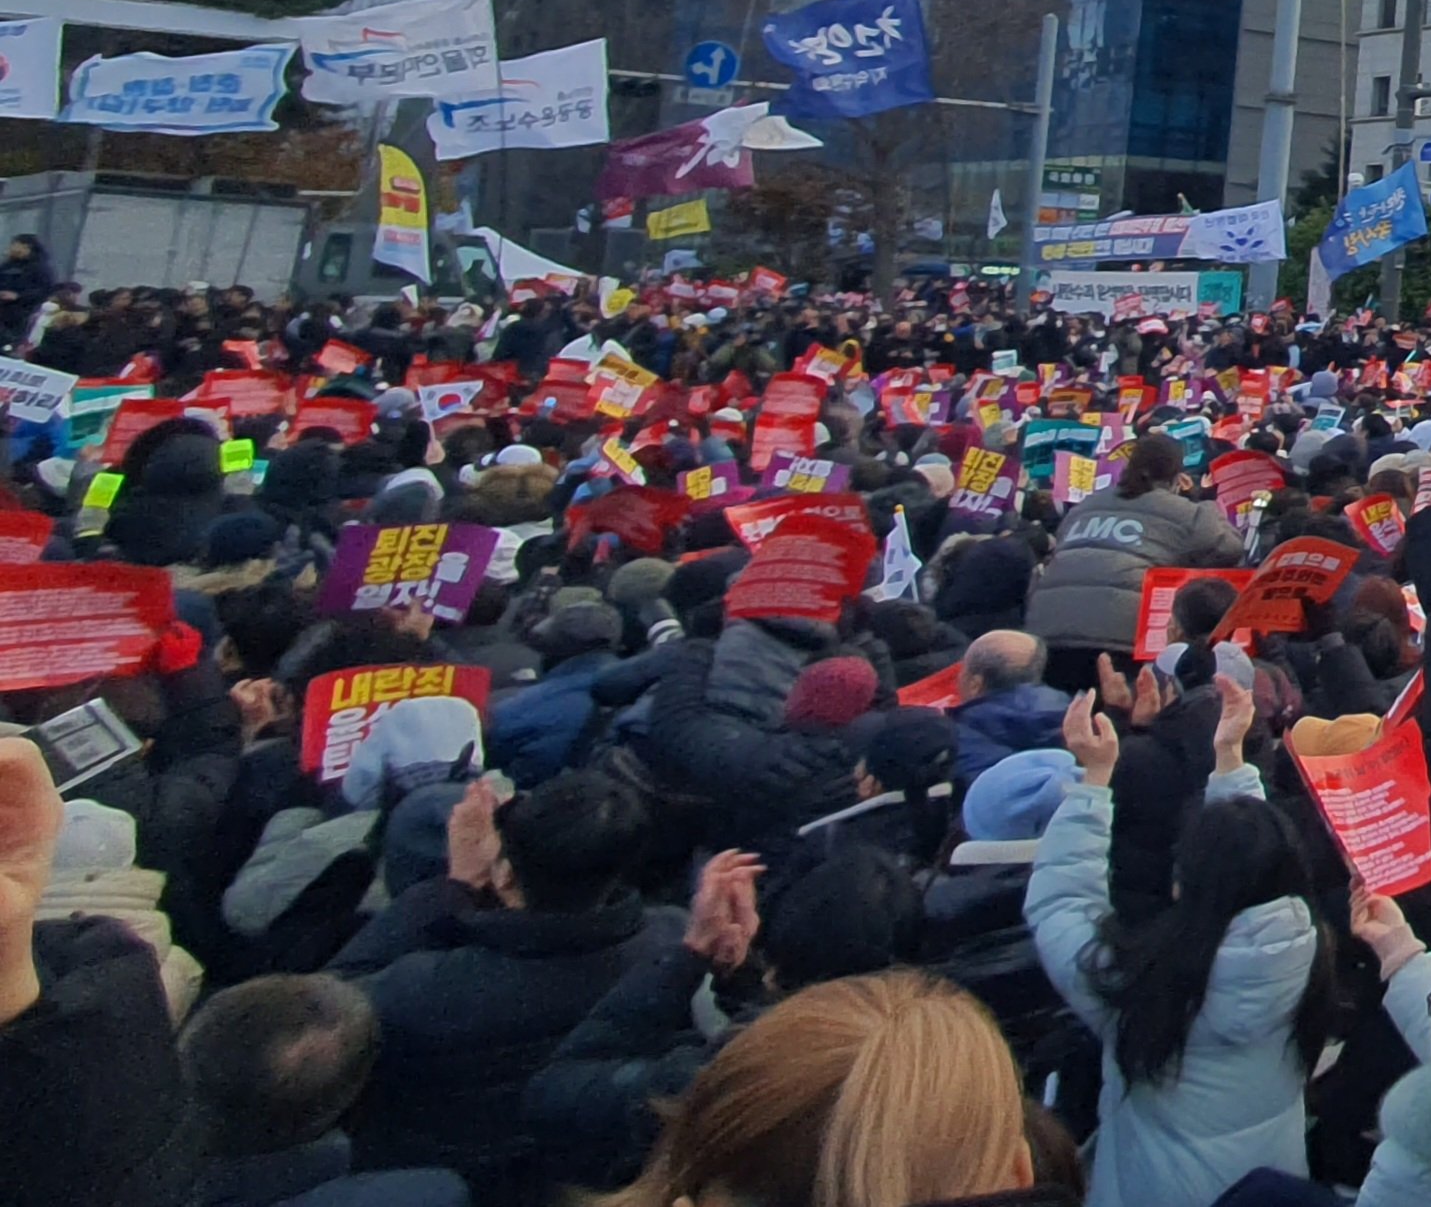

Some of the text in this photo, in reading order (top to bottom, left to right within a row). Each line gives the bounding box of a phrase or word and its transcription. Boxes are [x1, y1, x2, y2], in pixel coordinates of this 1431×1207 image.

[370, 523, 449, 554] 퇴진
[1063, 516, 1144, 543] LMC
[351, 579, 442, 611] 열자!
[330, 665, 456, 711] 내란죄
